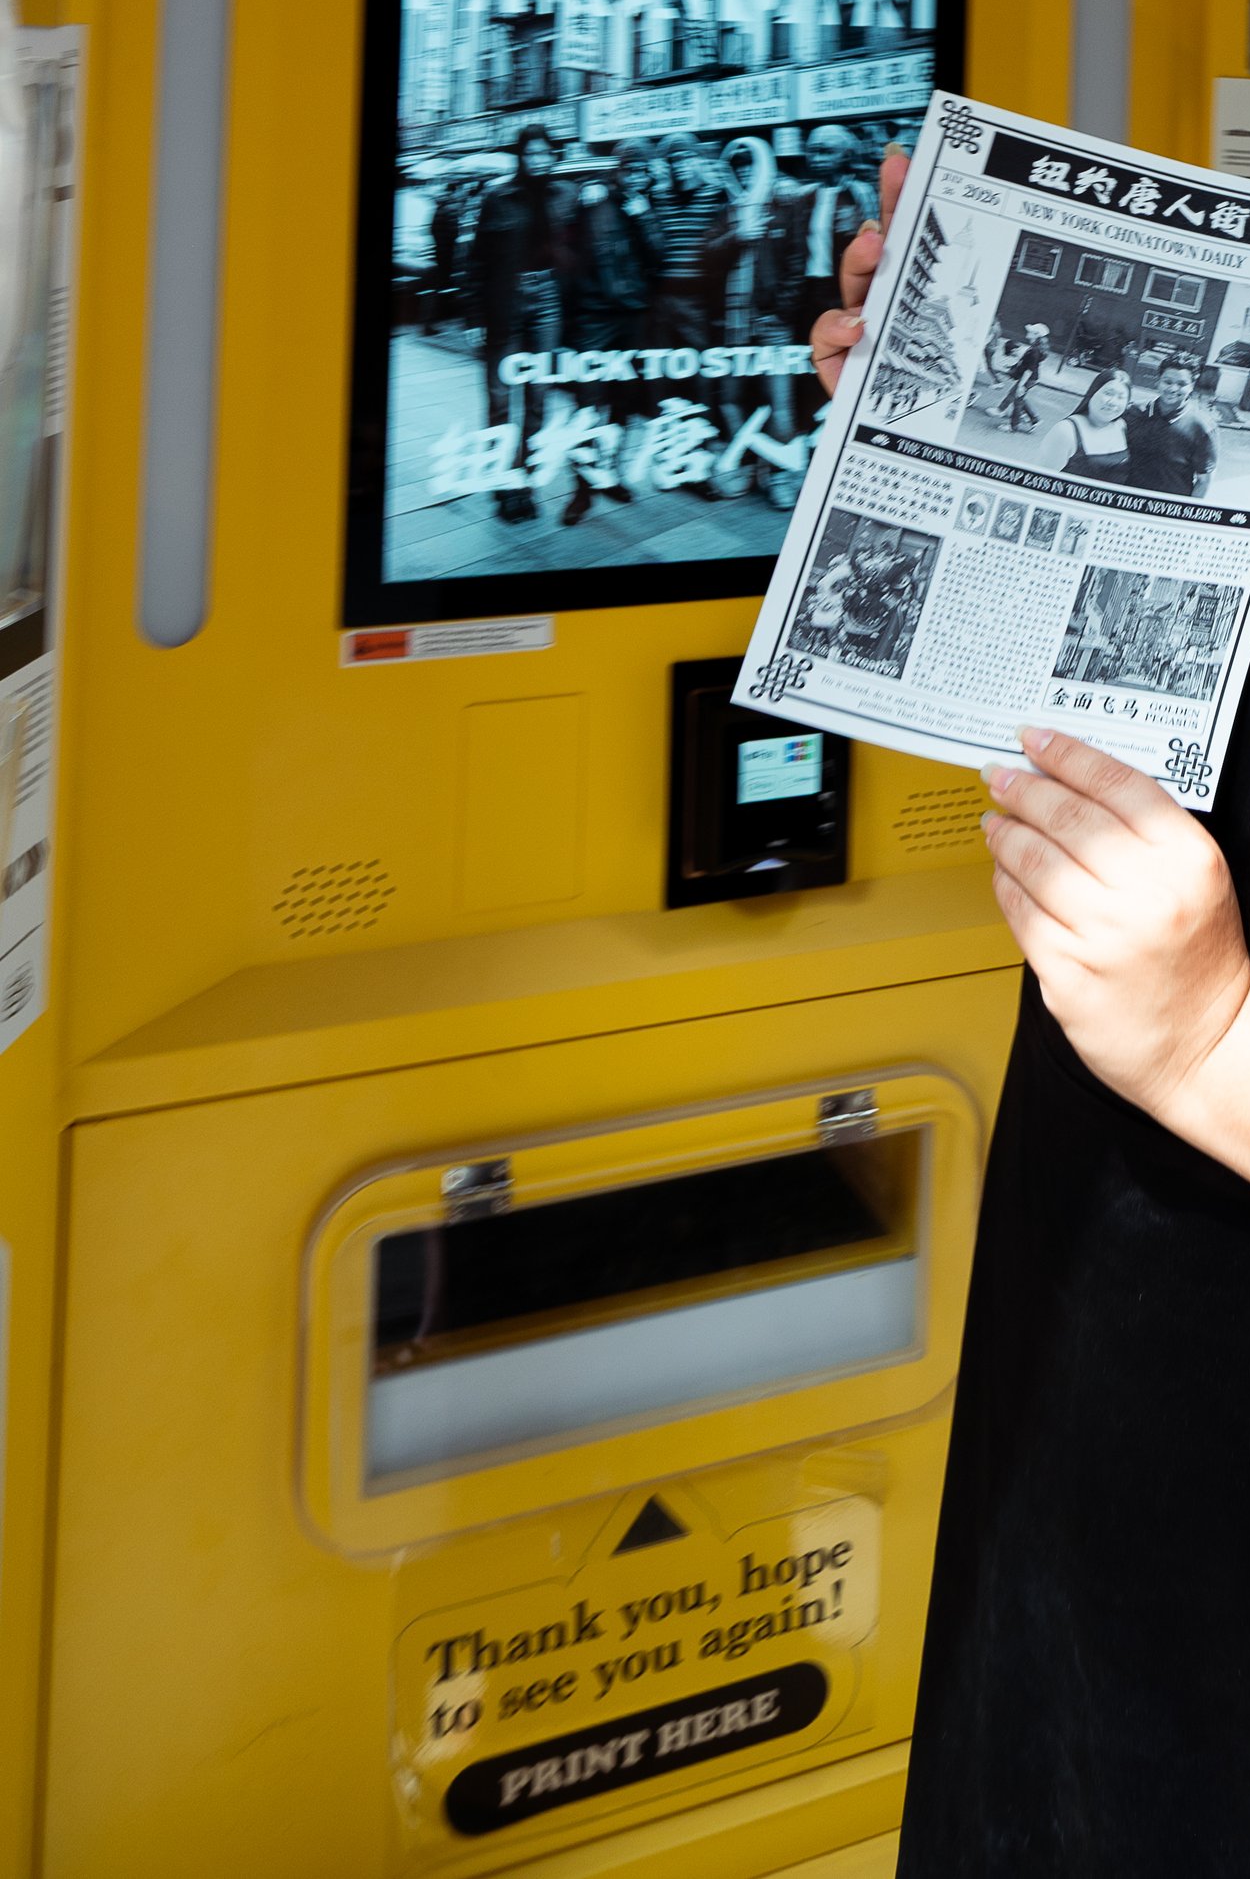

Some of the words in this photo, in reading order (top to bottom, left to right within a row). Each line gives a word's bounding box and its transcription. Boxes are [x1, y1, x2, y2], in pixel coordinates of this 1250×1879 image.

[1018, 200, 1058, 221] NEW
[1060, 209, 1104, 236] YORK
[1104, 224, 1200, 260] CHINATOWN
[1200, 247, 1248, 270] DAILY
[499, 350, 638, 386] CLICK
[638, 347, 700, 380] TO
[700, 344, 817, 377] STAR
[1065, 483, 1090, 500] THE
[1088, 489, 1118, 506] CITY
[1115, 493, 1147, 511] THAT
[1145, 500, 1183, 519] NEVER
[1181, 506, 1223, 523] SLEEPS
[1144, 712, 1199, 730] PEGASUS
[1149, 701, 1201, 719] GOLDEN
[425, 1599, 607, 1684] Thank
[616, 1580, 724, 1641] you,
[737, 1539, 854, 1599] hope
[426, 1695, 484, 1740] to
[498, 1667, 579, 1721] see
[592, 1639, 684, 1702] you
[698, 1578, 848, 1661] again!
[498, 1730, 652, 1808] PRINT
[655, 1688, 782, 1758] HERE
